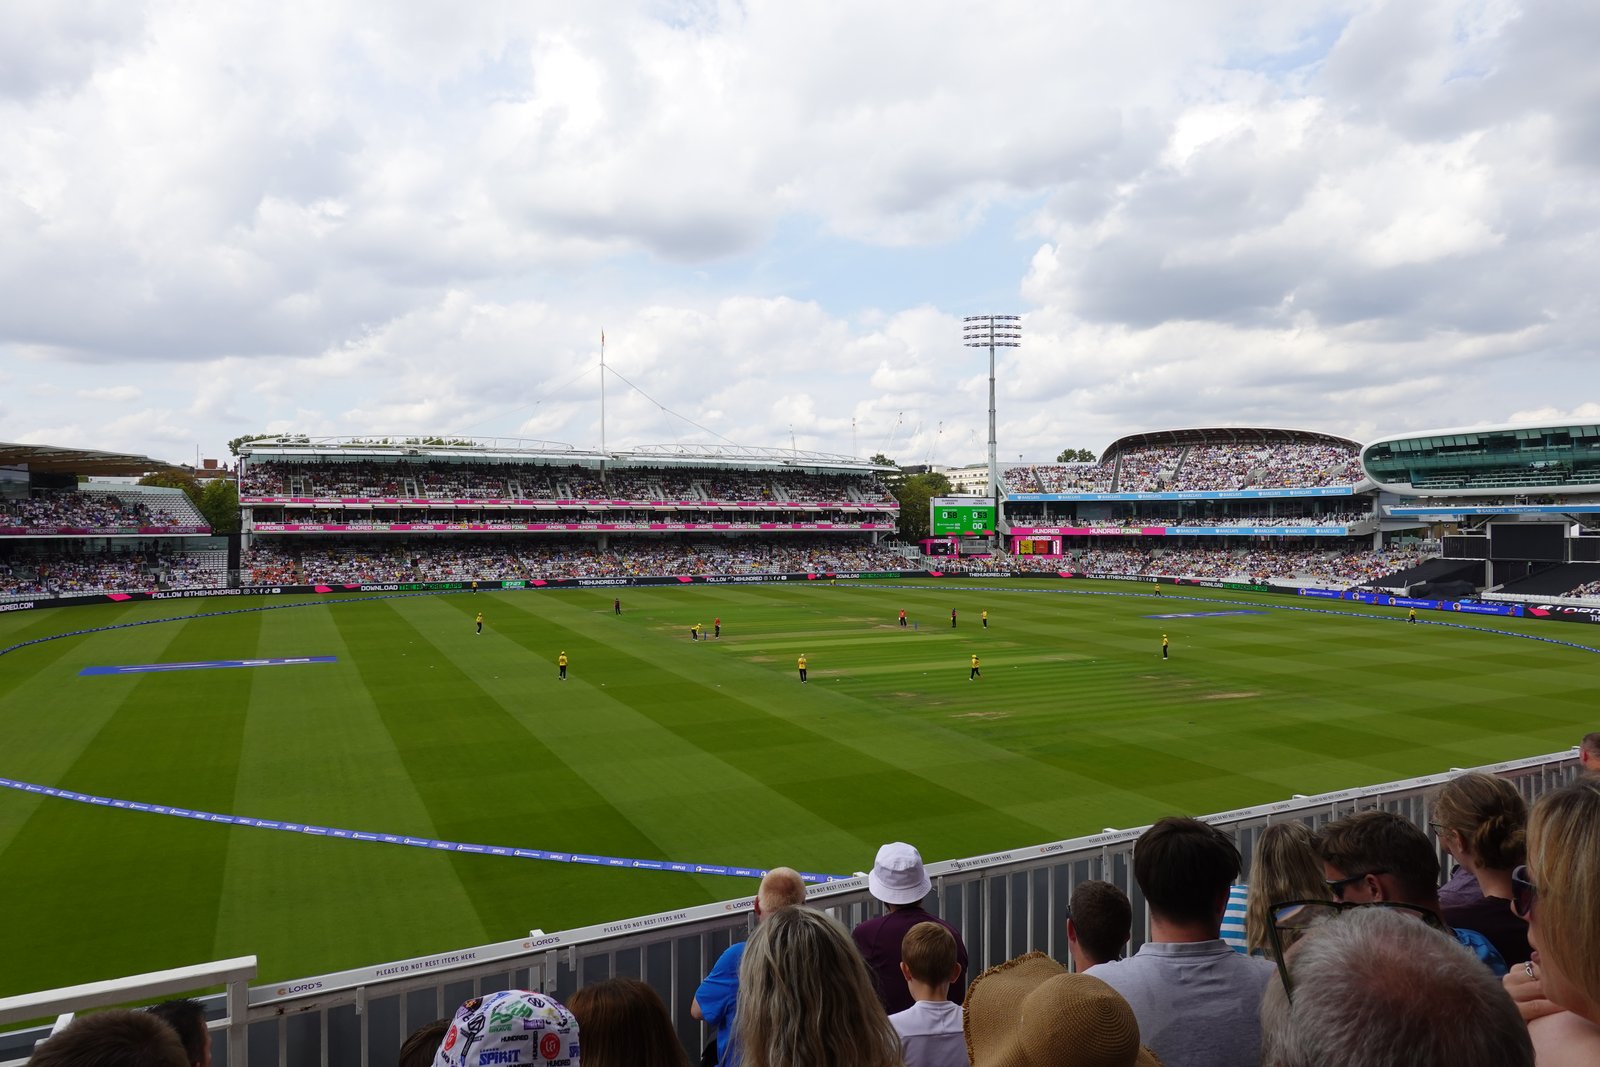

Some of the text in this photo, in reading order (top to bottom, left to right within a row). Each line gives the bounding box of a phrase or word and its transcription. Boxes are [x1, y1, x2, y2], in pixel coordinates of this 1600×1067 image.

[184, 588, 241, 597] @THEHUNDRED
[532, 937, 560, 947] LORD'S
[376, 968, 399, 977] PLEASE
[461, 953, 476, 961] HERE
[288, 981, 322, 994] LORD'S
